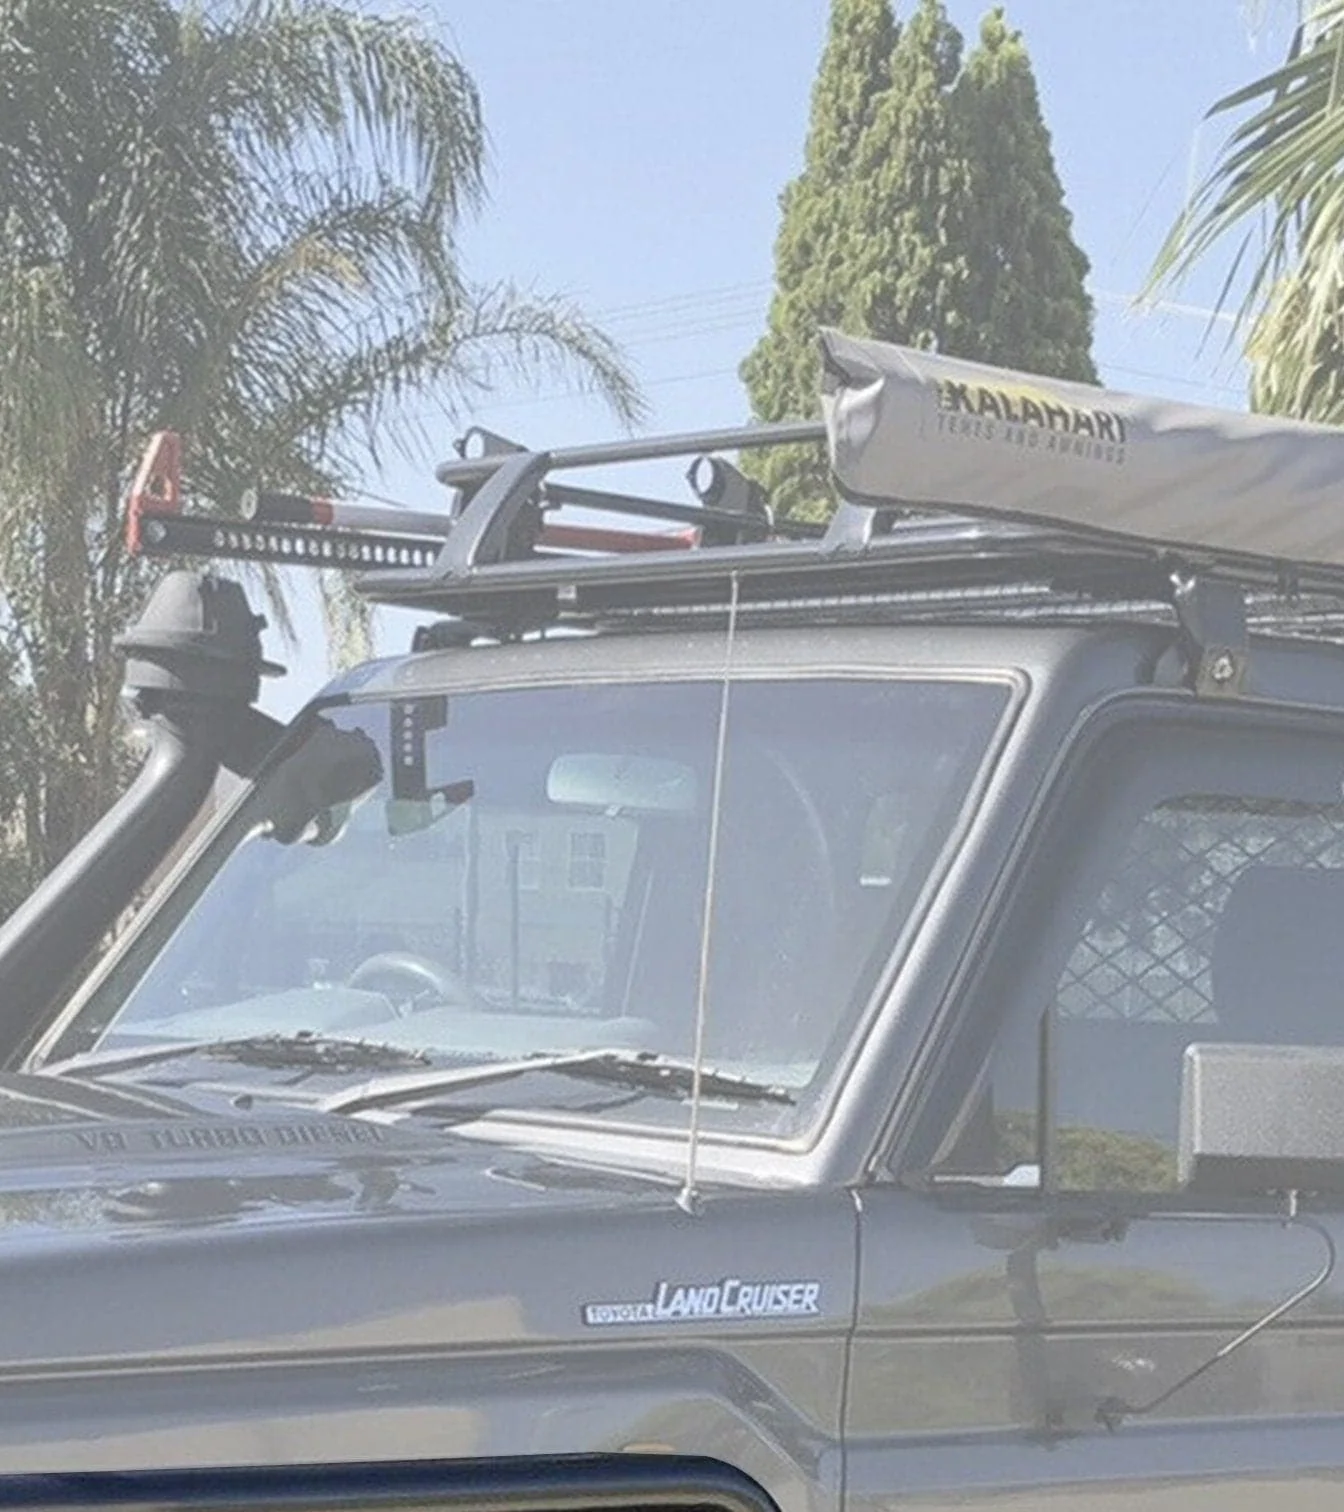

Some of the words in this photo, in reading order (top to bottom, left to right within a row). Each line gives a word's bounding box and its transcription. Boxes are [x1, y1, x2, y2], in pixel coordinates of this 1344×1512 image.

[945, 379, 1126, 443] KALAHARI
[150, 1125, 265, 1150] TURBO
[586, 1303, 655, 1325] TOYOTA
